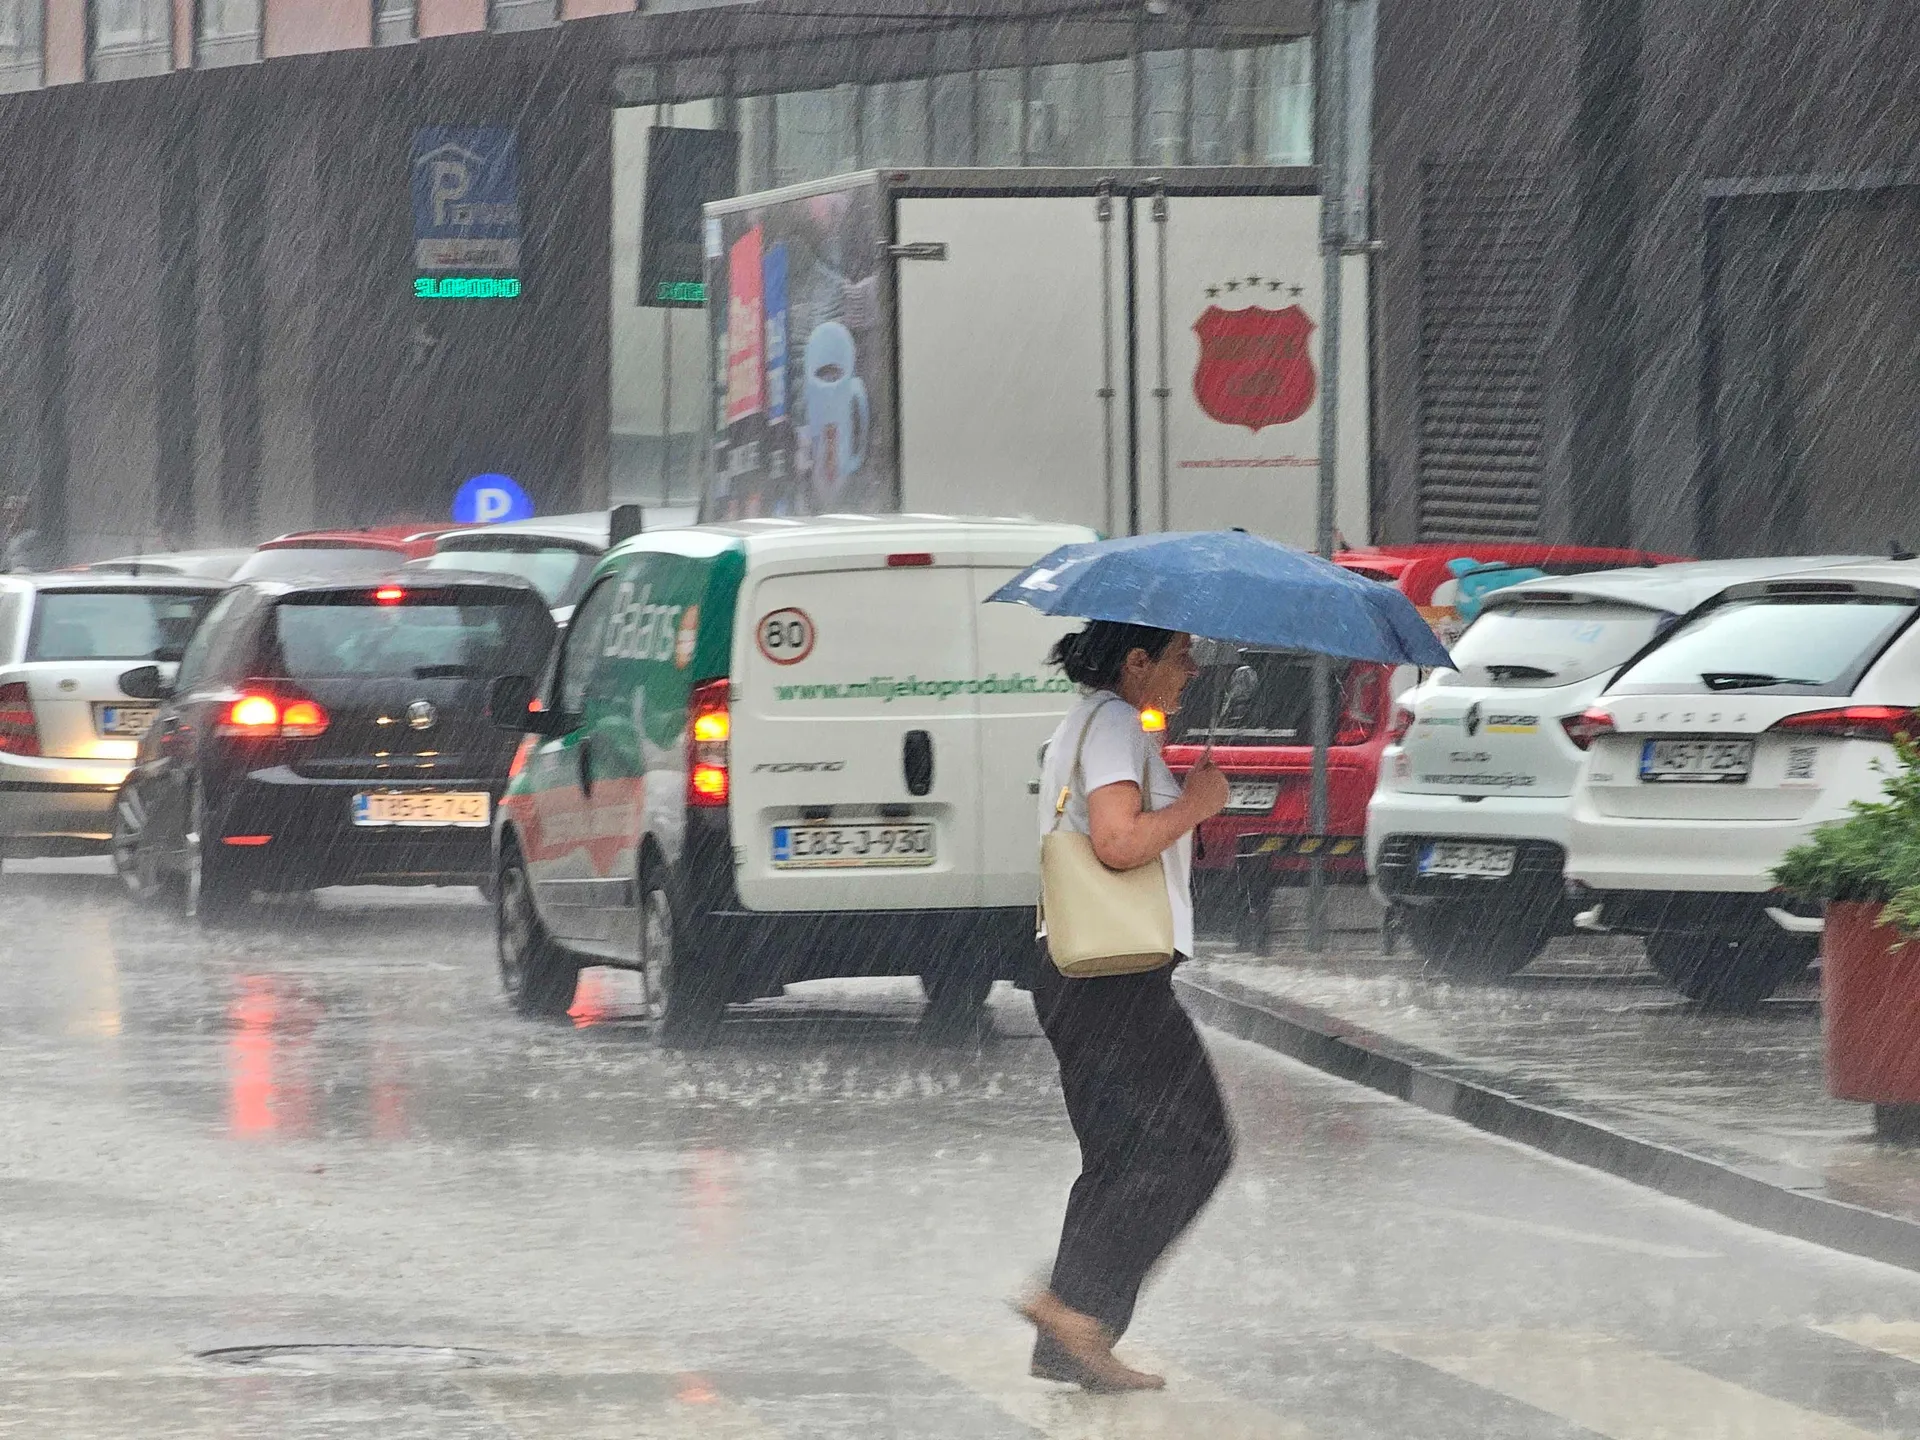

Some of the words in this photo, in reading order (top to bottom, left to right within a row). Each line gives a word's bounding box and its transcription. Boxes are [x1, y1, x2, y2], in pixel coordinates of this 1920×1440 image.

[476, 488, 512, 522] P
[767, 620, 804, 648] 80
[774, 673, 1078, 701] www.mlijekoprodukt.co
[793, 829, 930, 855] E83-J-930
